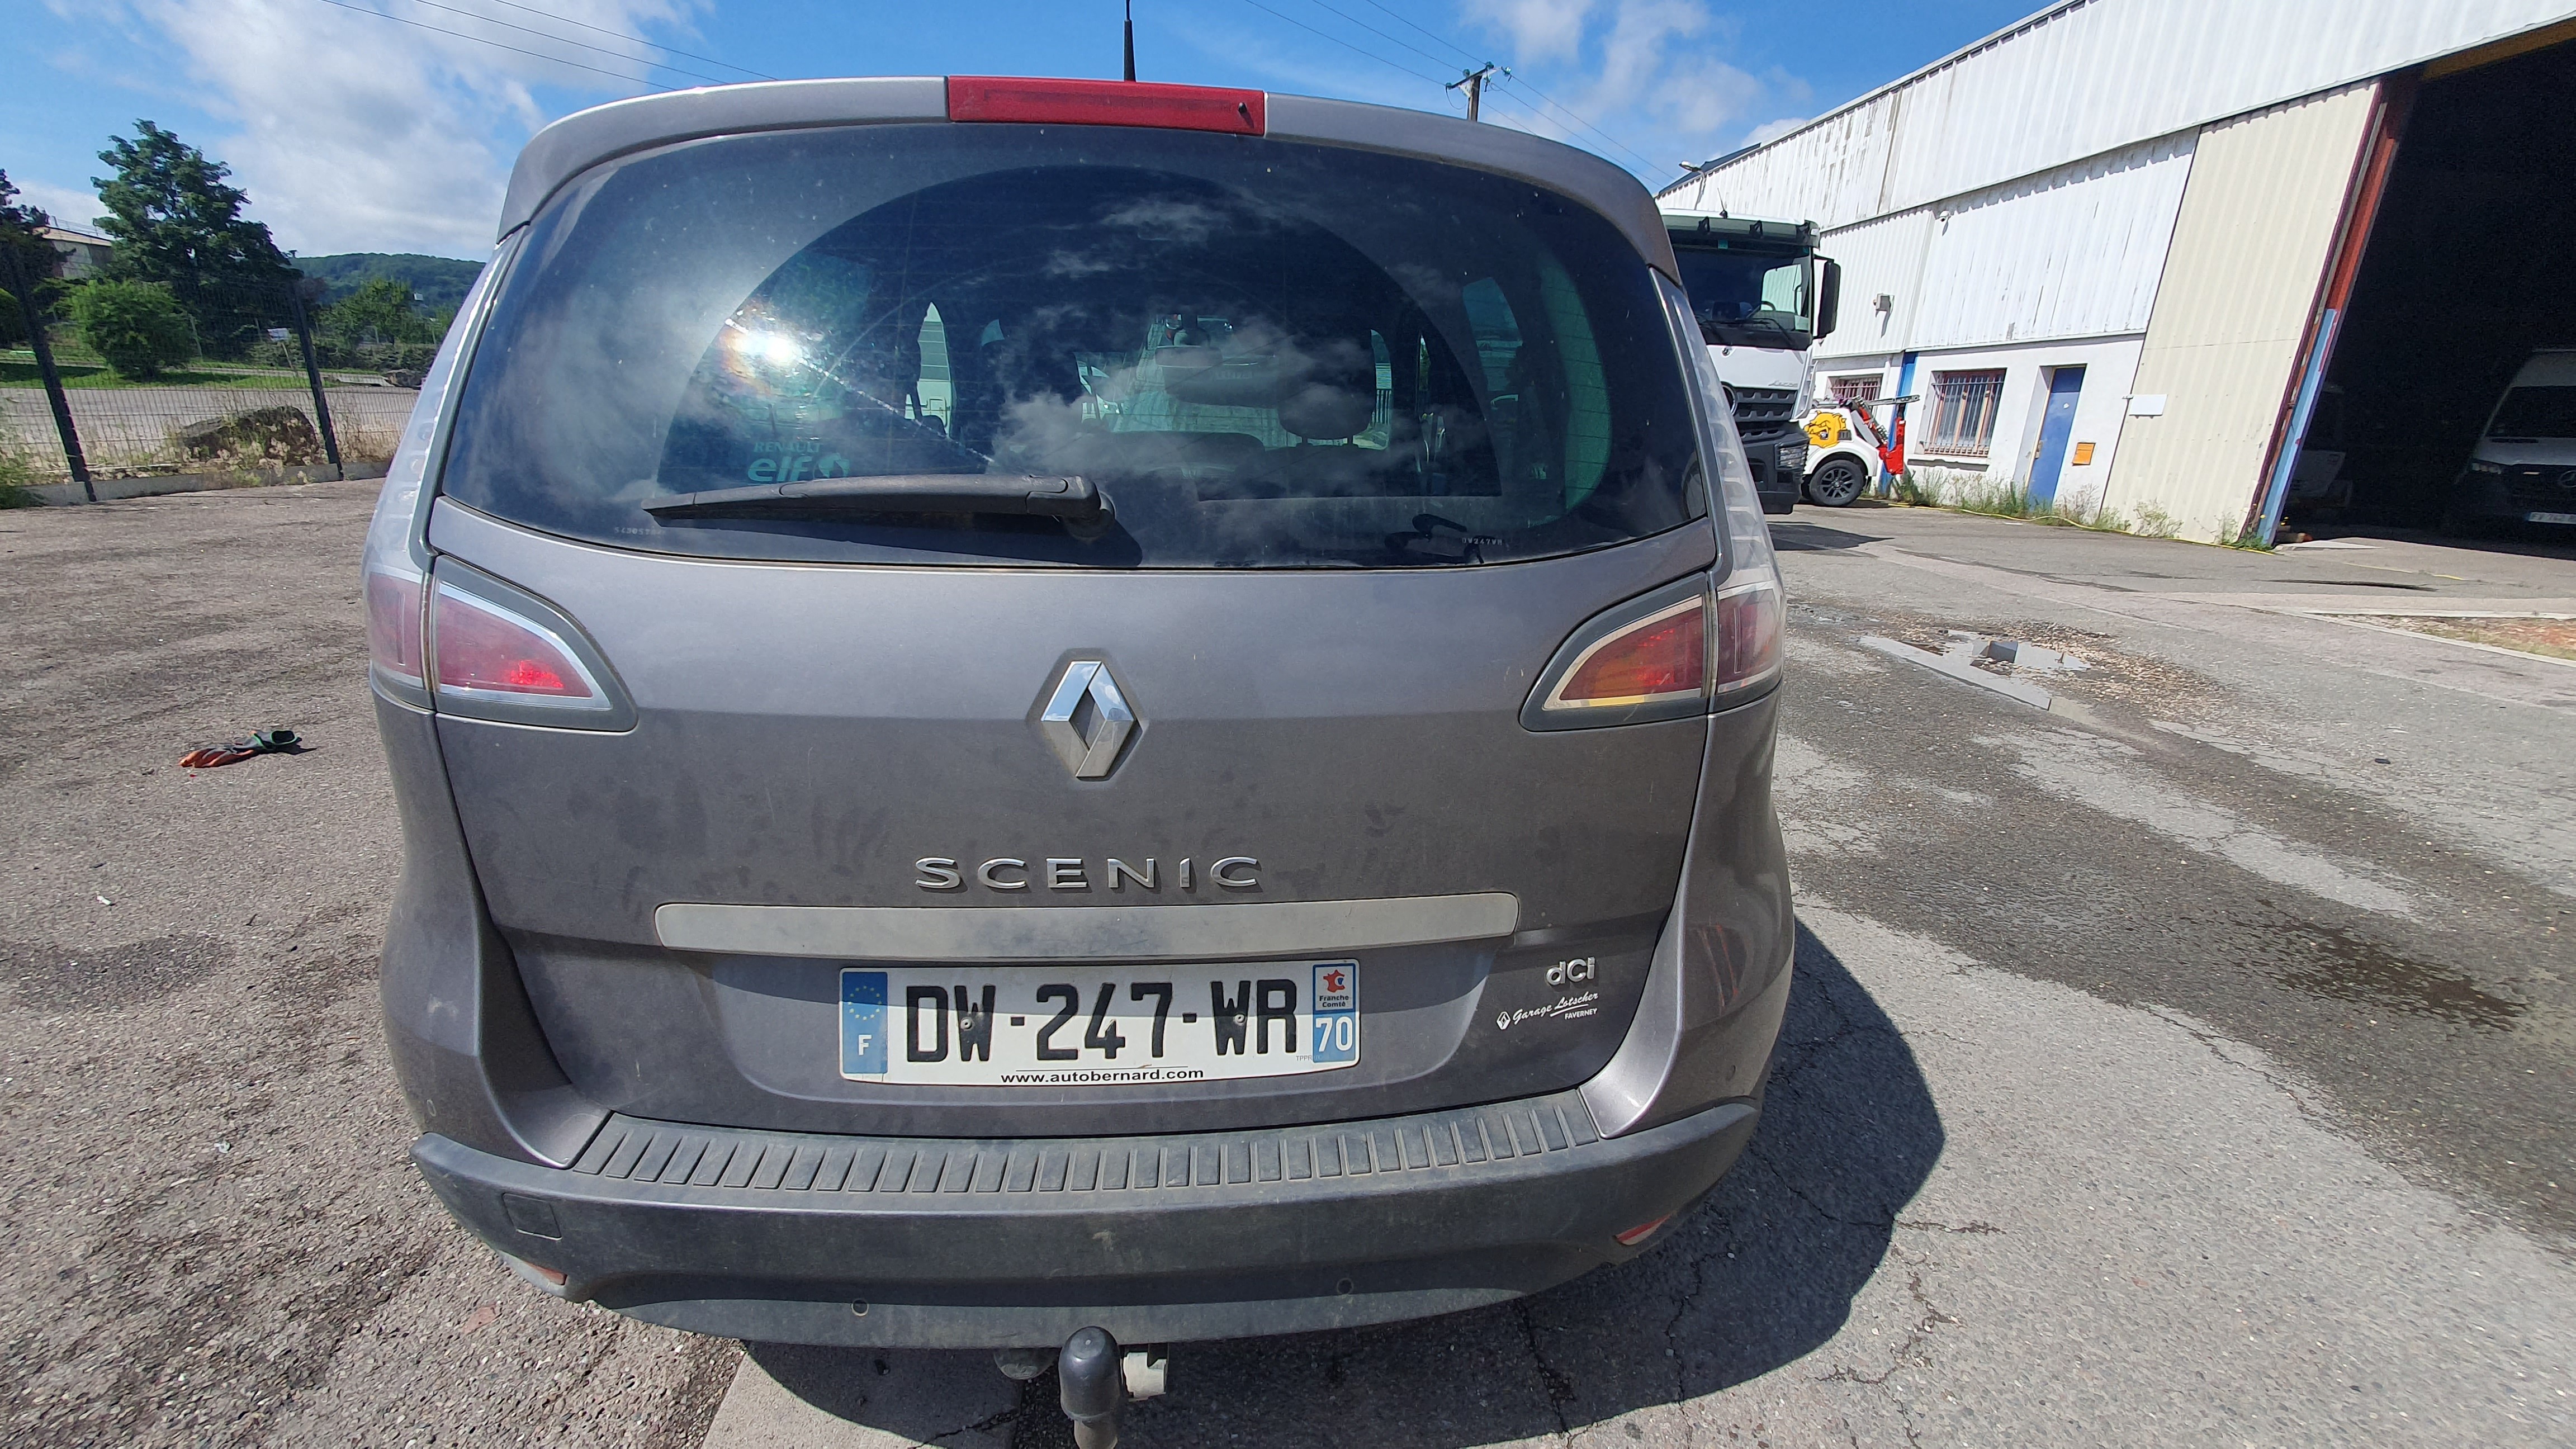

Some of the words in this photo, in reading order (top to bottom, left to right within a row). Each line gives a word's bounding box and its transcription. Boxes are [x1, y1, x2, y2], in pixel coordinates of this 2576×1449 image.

[747, 456, 812, 482] elf
[915, 857, 1257, 888] SCENIC
[1546, 956, 1595, 986] dCi
[906, 979, 1297, 1062] DW-247-WR
[1513, 1005, 1552, 1025] Garage
[1554, 991, 1598, 1010] Lotscher
[1565, 1008, 1598, 1020] FAVERNEY
[858, 1034, 872, 1055] F
[1315, 1016, 1353, 1052] 70
[1001, 1069, 1204, 1082] www.autobernard.com
